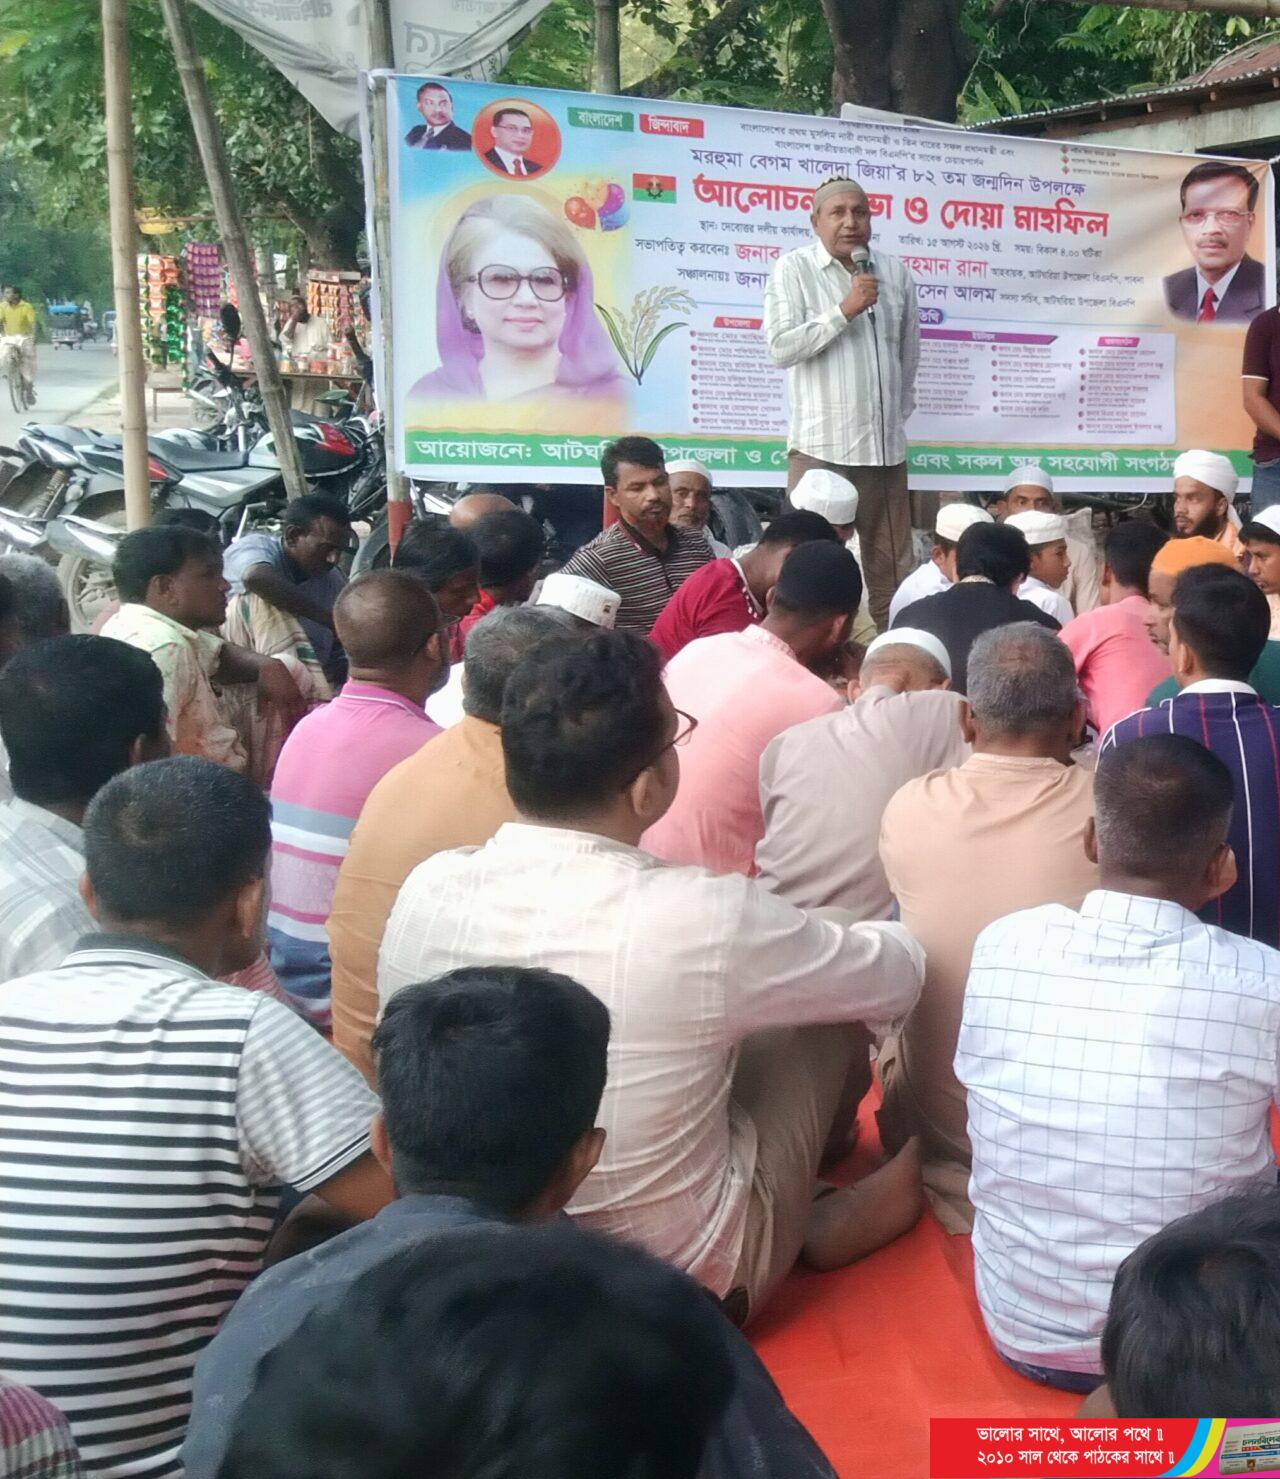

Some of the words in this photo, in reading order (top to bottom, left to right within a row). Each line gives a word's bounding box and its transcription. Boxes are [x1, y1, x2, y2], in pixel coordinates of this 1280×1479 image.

[578, 110, 623, 128] বাংলাদেশ
[648, 115, 690, 134] জিন্দাবাদ
[740, 124, 785, 135] বাংলাদেশের
[789, 128, 807, 137] প্রথম
[810, 128, 835, 139] মুসলিম
[839, 130, 853, 140] নারী
[775, 140, 811, 150] বাংলাদেশ
[814, 143, 862, 154] জাতীয়তাবাদী
[865, 148, 878, 157] দল
[918, 153, 942, 162] সাবেক
[690, 149, 743, 169] মরহুমা
[750, 154, 792, 172] বেগম
[798, 158, 850, 177] খালেদা
[856, 159, 908, 182] জিয়া'র
[913, 169, 936, 186] ৮২
[941, 171, 967, 187] তম
[972, 171, 1024, 192] জন্মদিন
[1029, 176, 1086, 197] উপলক্ষে
[692, 173, 815, 214] আলোচন
[866, 193, 893, 219] ভা
[904, 197, 928, 224] ও
[941, 200, 1004, 230] দোয়া
[1013, 197, 1109, 237] মাহফিল
[635, 237, 685, 257] সভাপতিত্ব
[734, 243, 782, 263] জনাব
[956, 260, 989, 279] রানা
[734, 271, 770, 289] জনা
[952, 286, 997, 303] আলম
[658, 443, 738, 465] পজেলা
[745, 450, 761, 464] ও
[912, 453, 952, 471] এবং
[956, 454, 1004, 471] সকল
[1046, 451, 1119, 472] সহযোগী
